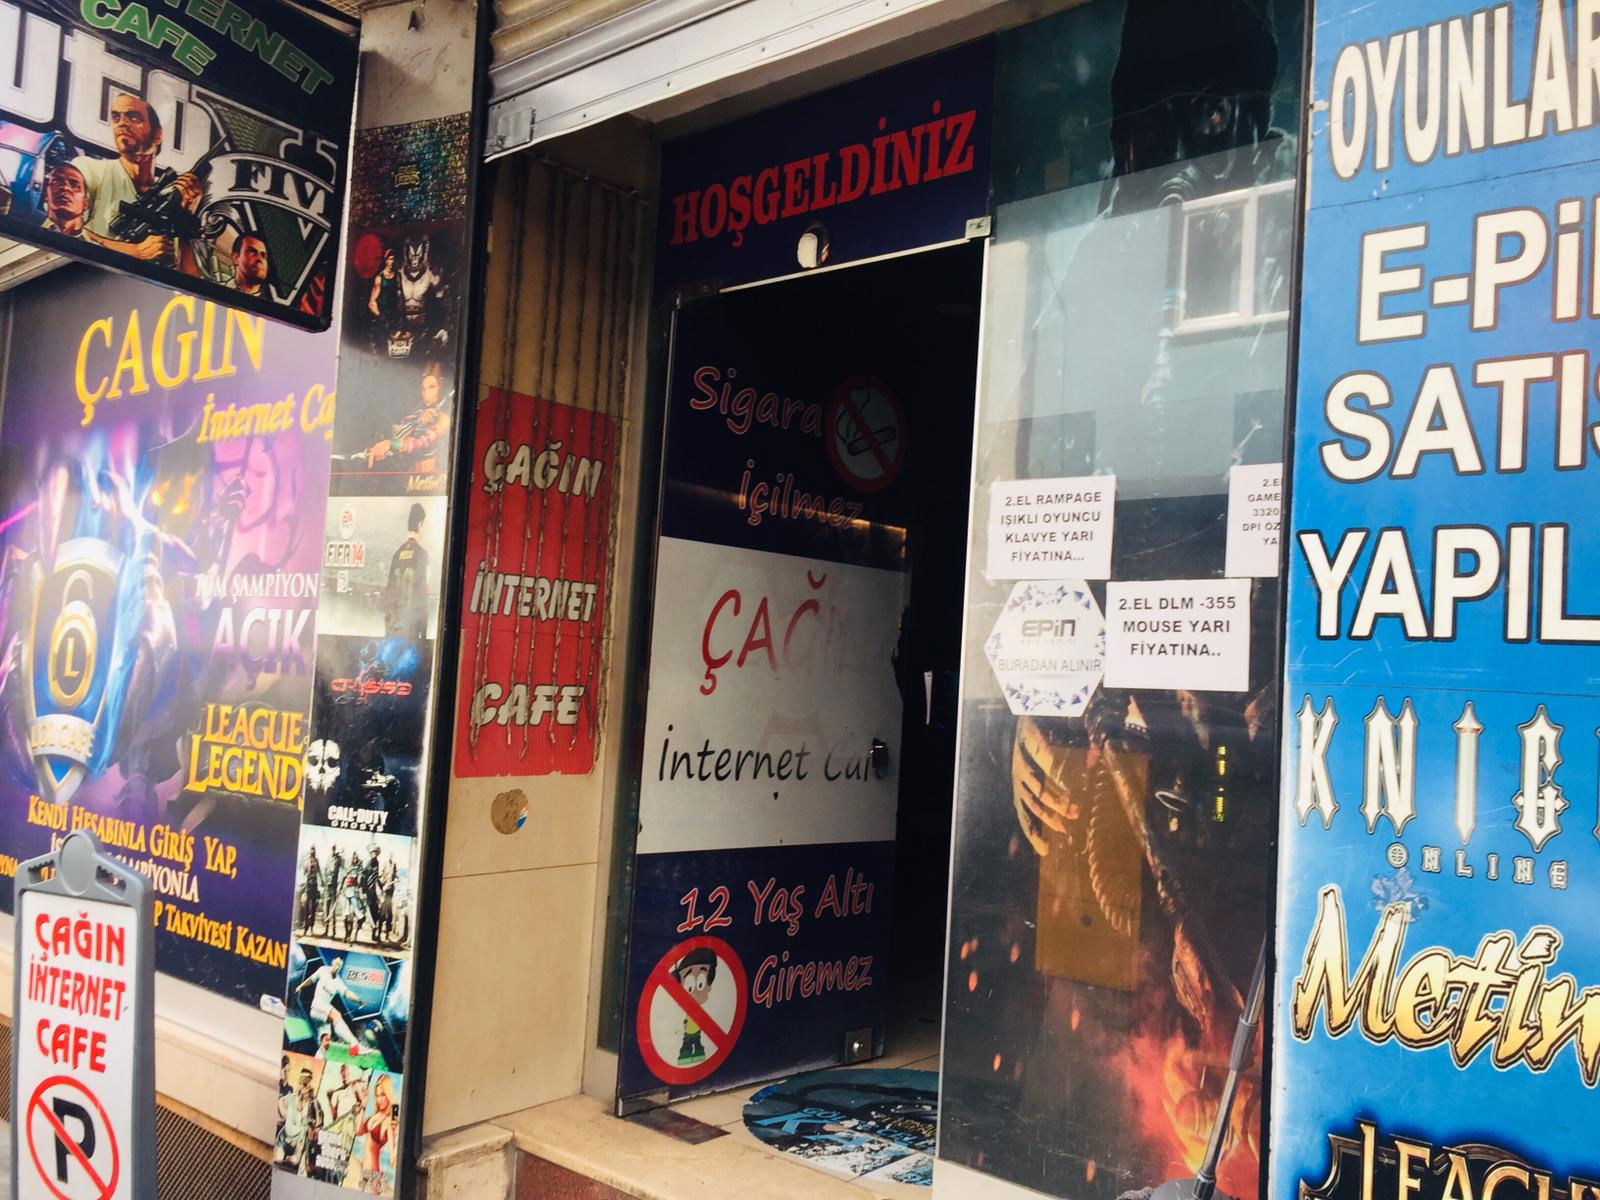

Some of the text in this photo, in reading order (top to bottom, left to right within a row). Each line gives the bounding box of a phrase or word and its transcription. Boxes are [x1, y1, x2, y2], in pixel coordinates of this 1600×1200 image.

[81, 0, 217, 76] CAFE
[229, 158, 335, 226] FIV
[671, 100, 977, 248] HOŞGELDİNİZ
[1357, 193, 1600, 344] E-Pi
[301, 384, 336, 440] Ca
[690, 366, 823, 437] Sigara
[1319, 349, 1600, 484] SATI
[484, 440, 603, 499] ÇAĞIN
[738, 459, 864, 529] İçilmez
[1005, 491, 1102, 507] 2.EL RAMPAGE
[1043, 511, 1101, 523] OYUNCU
[1005, 531, 1094, 543] KLAVYE YARI
[470, 559, 597, 623] İNTERNET
[1119, 596, 1236, 611] 2.EL DLM -355
[1123, 620, 1230, 633] MOUSE YARI
[998, 659, 1057, 672] BURADAN
[201, 703, 305, 754] LEAGUE
[471, 682, 585, 727] CAFE
[183, 734, 308, 811] LEGEND
[1295, 693, 1600, 853] KNIG
[27, 795, 68, 832] KENDİ
[1387, 842, 1568, 889] ONLINE
[676, 867, 876, 936] 12 Yaş Altı
[35, 911, 125, 967] ÇAĞIN
[235, 925, 289, 969] KAZAN
[28, 953, 127, 1021] İNTERNET
[752, 950, 873, 1008] Giremez
[1291, 884, 1600, 1089] Metin
[37, 1018, 107, 1074] CAFE
